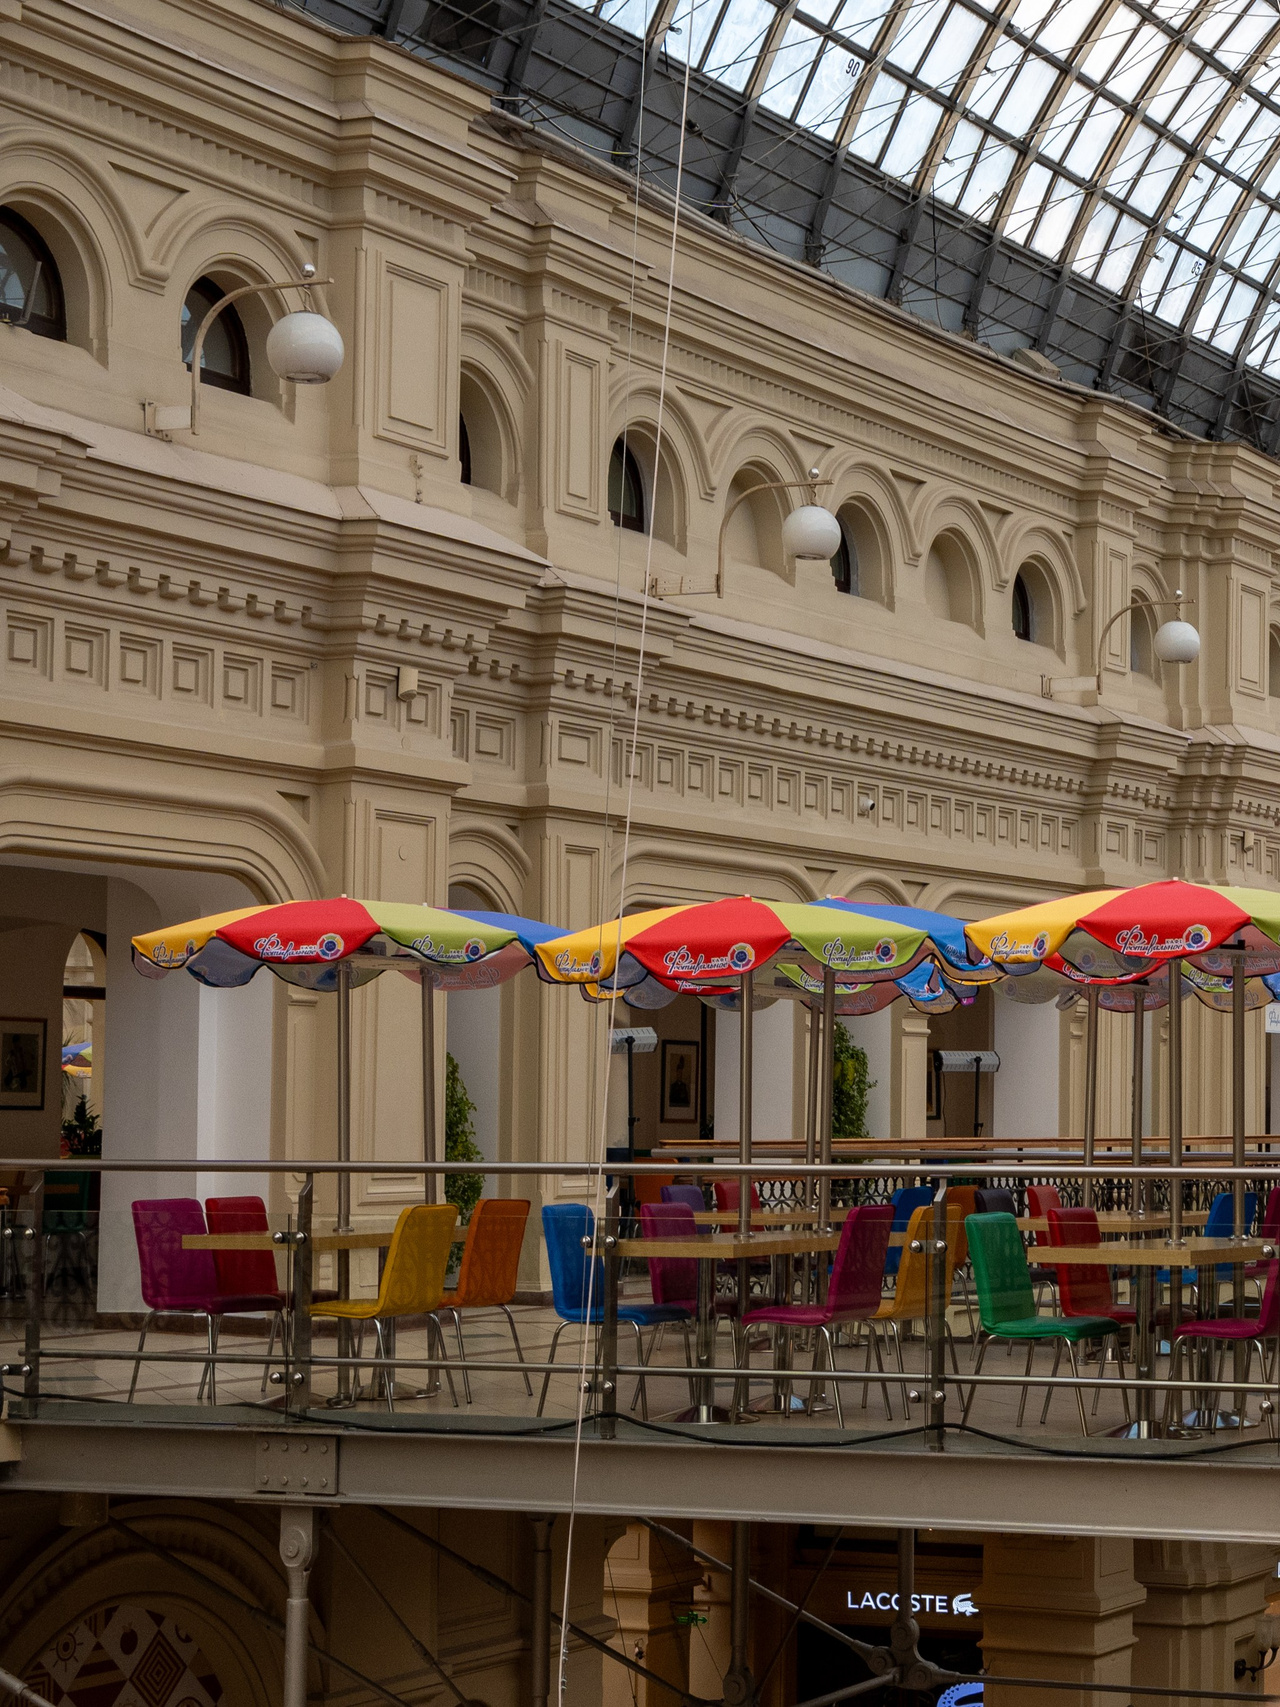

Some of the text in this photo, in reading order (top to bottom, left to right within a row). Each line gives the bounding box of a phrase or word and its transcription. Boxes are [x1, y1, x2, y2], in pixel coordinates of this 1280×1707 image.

[845, 58, 861, 78] 90
[254, 933, 317, 960] Фестивальное
[823, 937, 874, 967] Фестивальное
[1116, 925, 1183, 955] Фестивальное
[663, 945, 728, 975] Фестивальное
